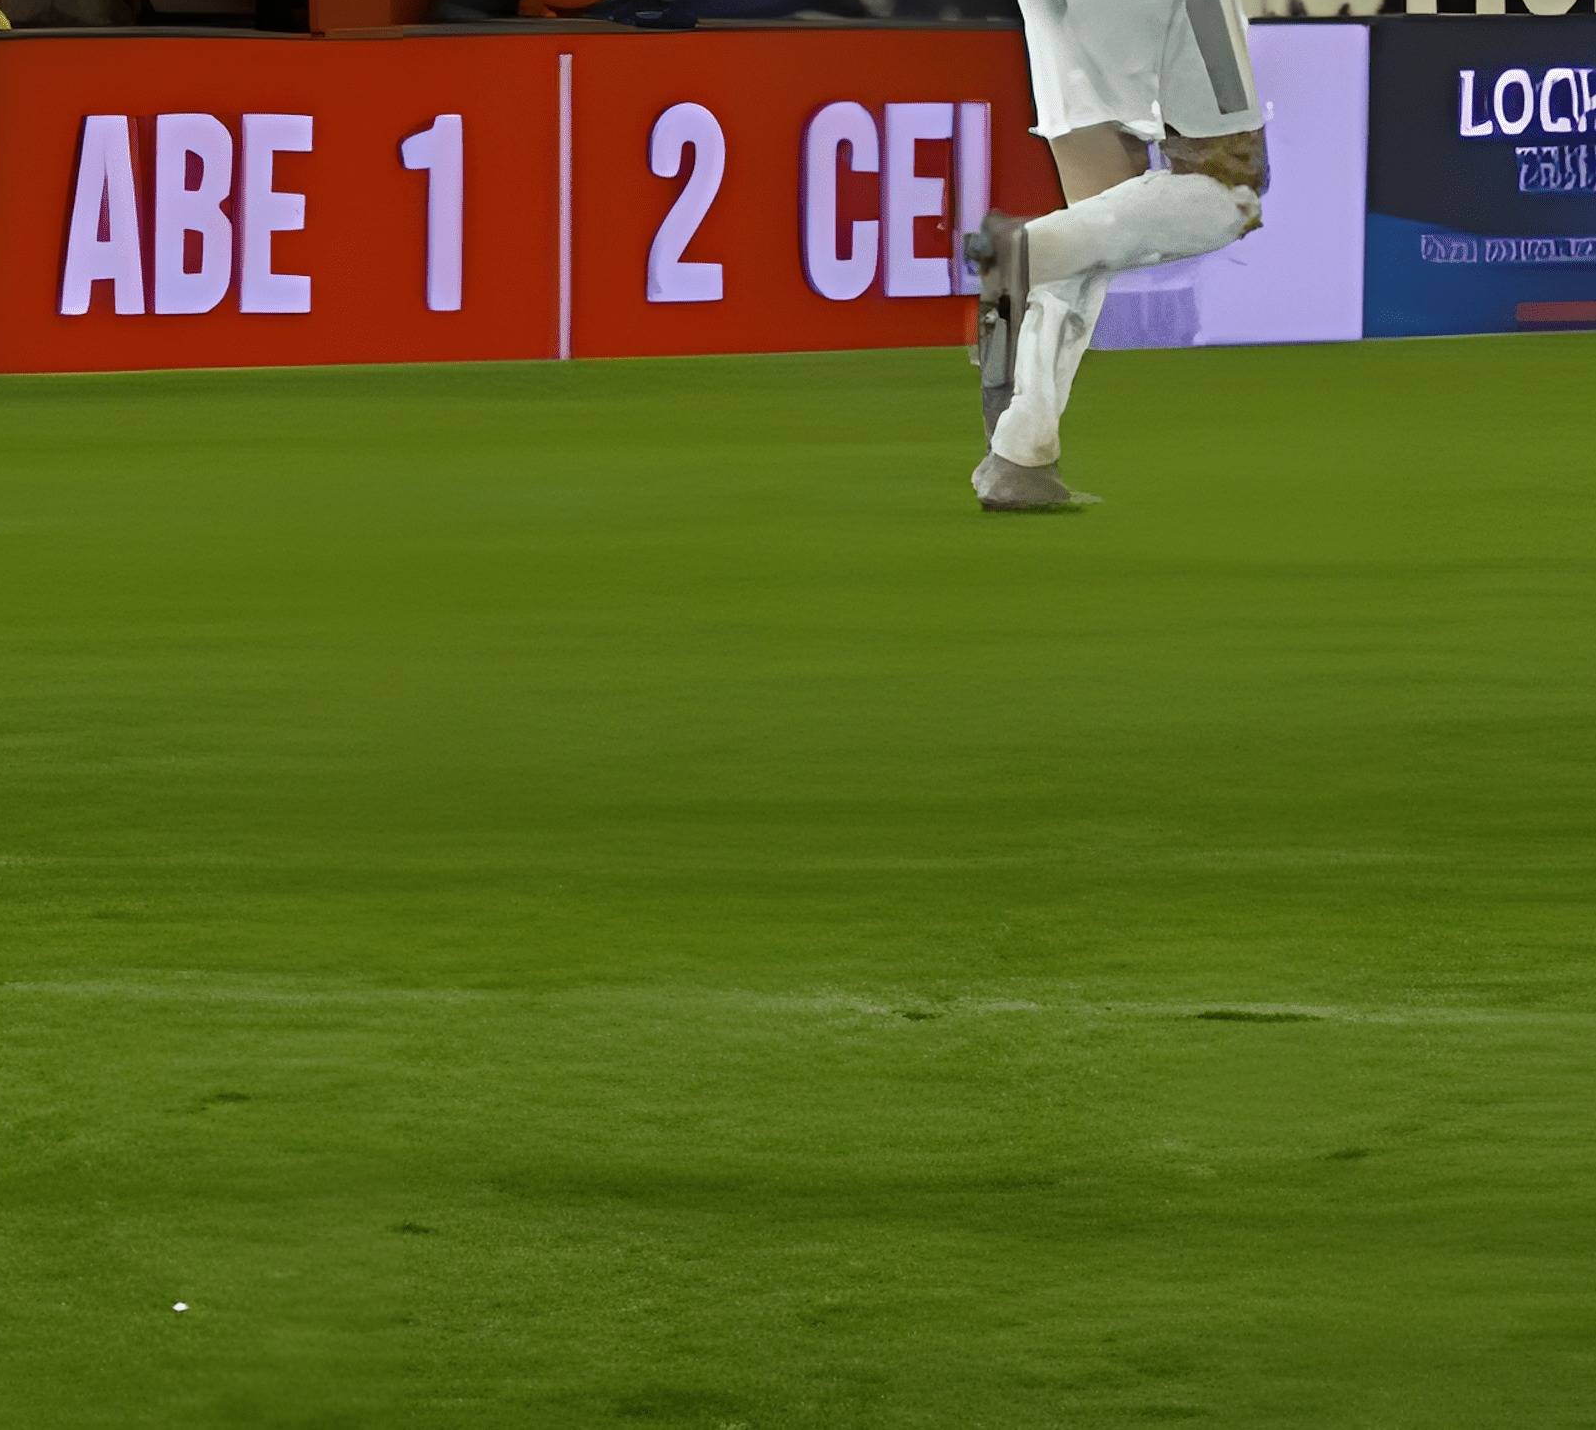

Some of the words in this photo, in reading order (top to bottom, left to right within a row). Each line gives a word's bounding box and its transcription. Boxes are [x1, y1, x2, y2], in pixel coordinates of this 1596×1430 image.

[59, 113, 314, 316] ABE
[402, 114, 464, 312] 1
[647, 102, 726, 303] 2
